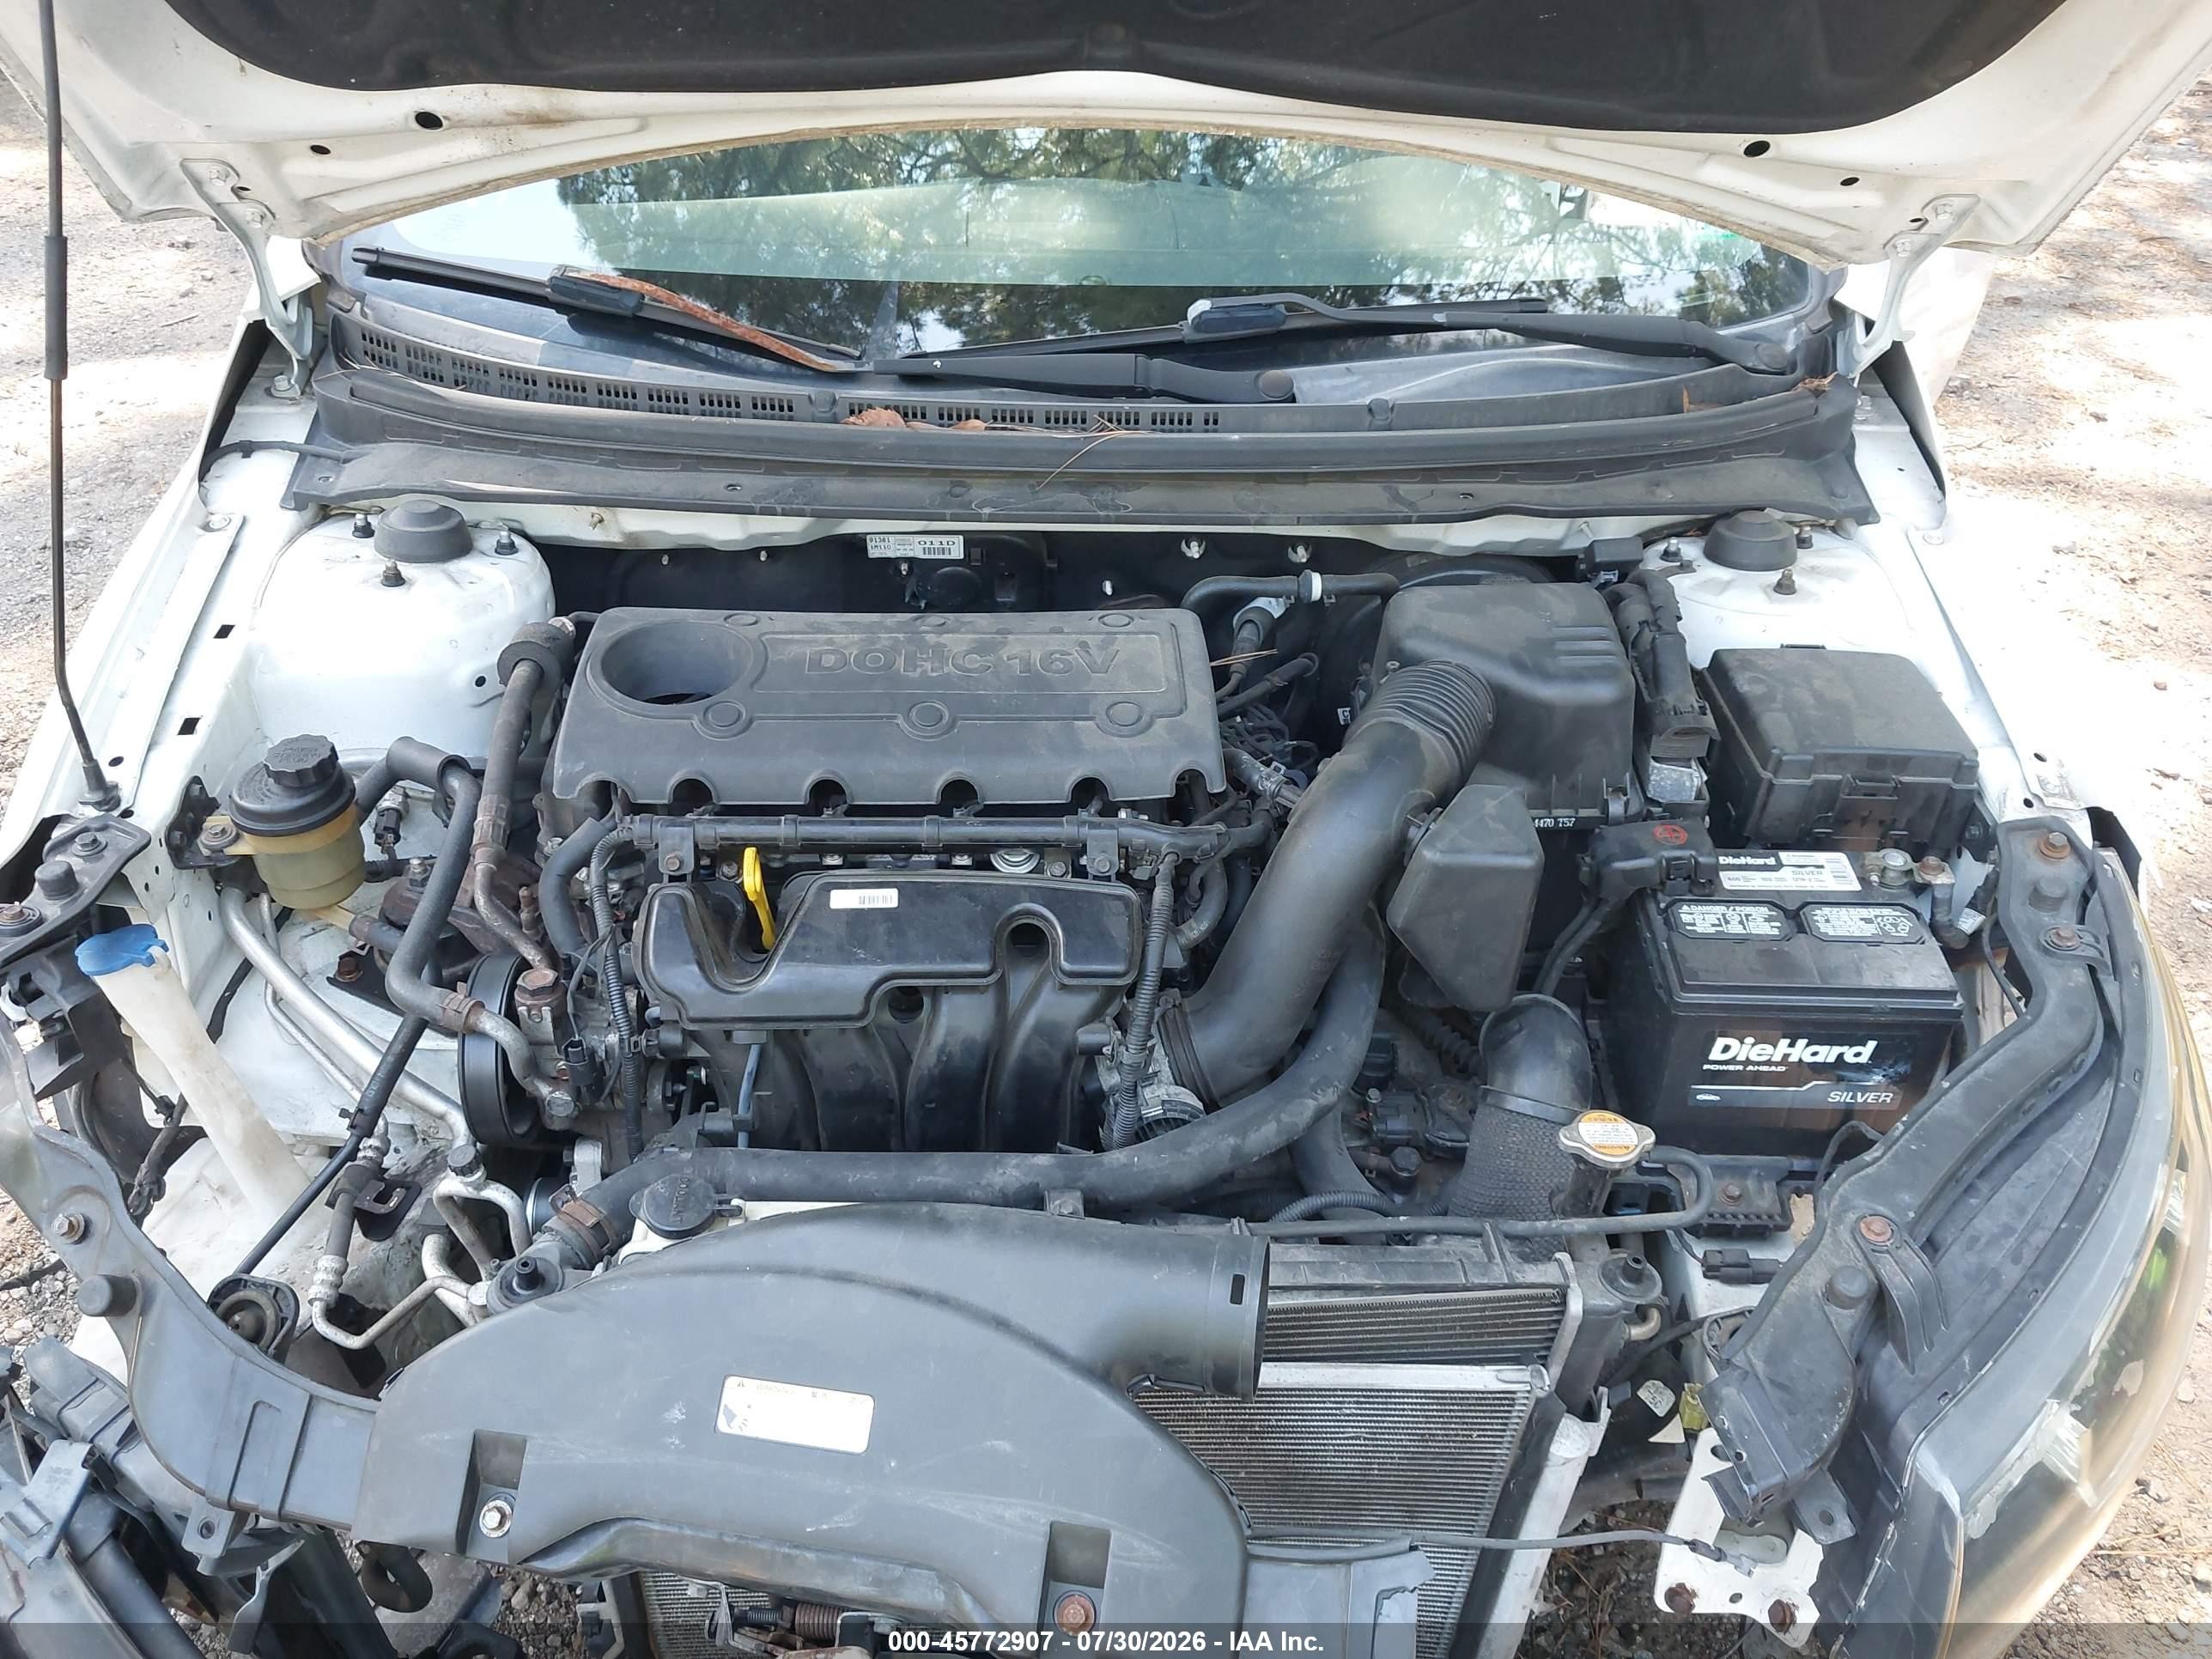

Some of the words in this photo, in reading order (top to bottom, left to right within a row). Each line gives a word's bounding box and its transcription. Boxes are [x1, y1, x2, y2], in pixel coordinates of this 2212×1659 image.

[805, 647, 995, 676] DOHC
[1006, 647, 1120, 677] 16V
[1718, 855, 1777, 866] DieHard
[1708, 1036, 1878, 1064] DieHard
[1827, 1091, 1894, 1104] SILVER
